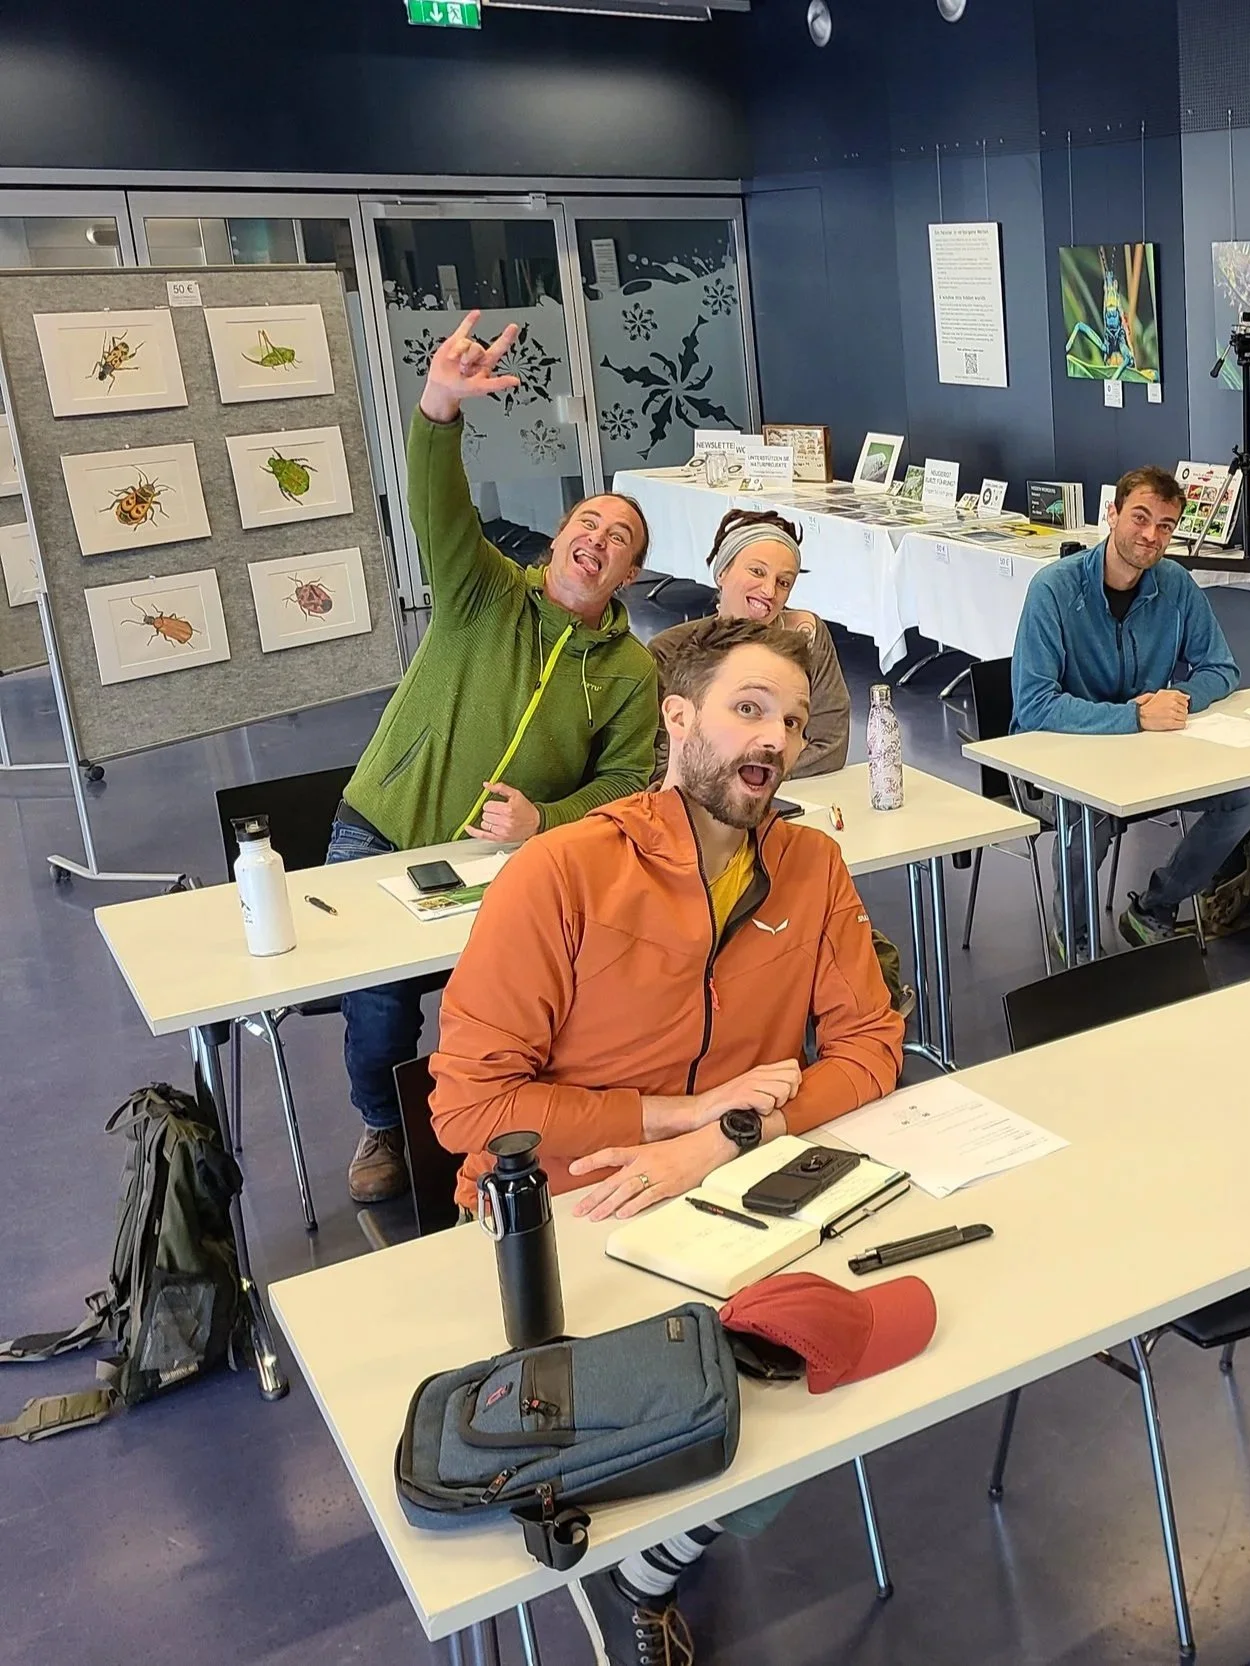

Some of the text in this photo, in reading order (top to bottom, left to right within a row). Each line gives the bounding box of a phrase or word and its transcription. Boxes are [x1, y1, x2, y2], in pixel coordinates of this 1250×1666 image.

[173, 284, 194, 294] 50 €
[696, 441, 736, 450] NEWSLETTE
